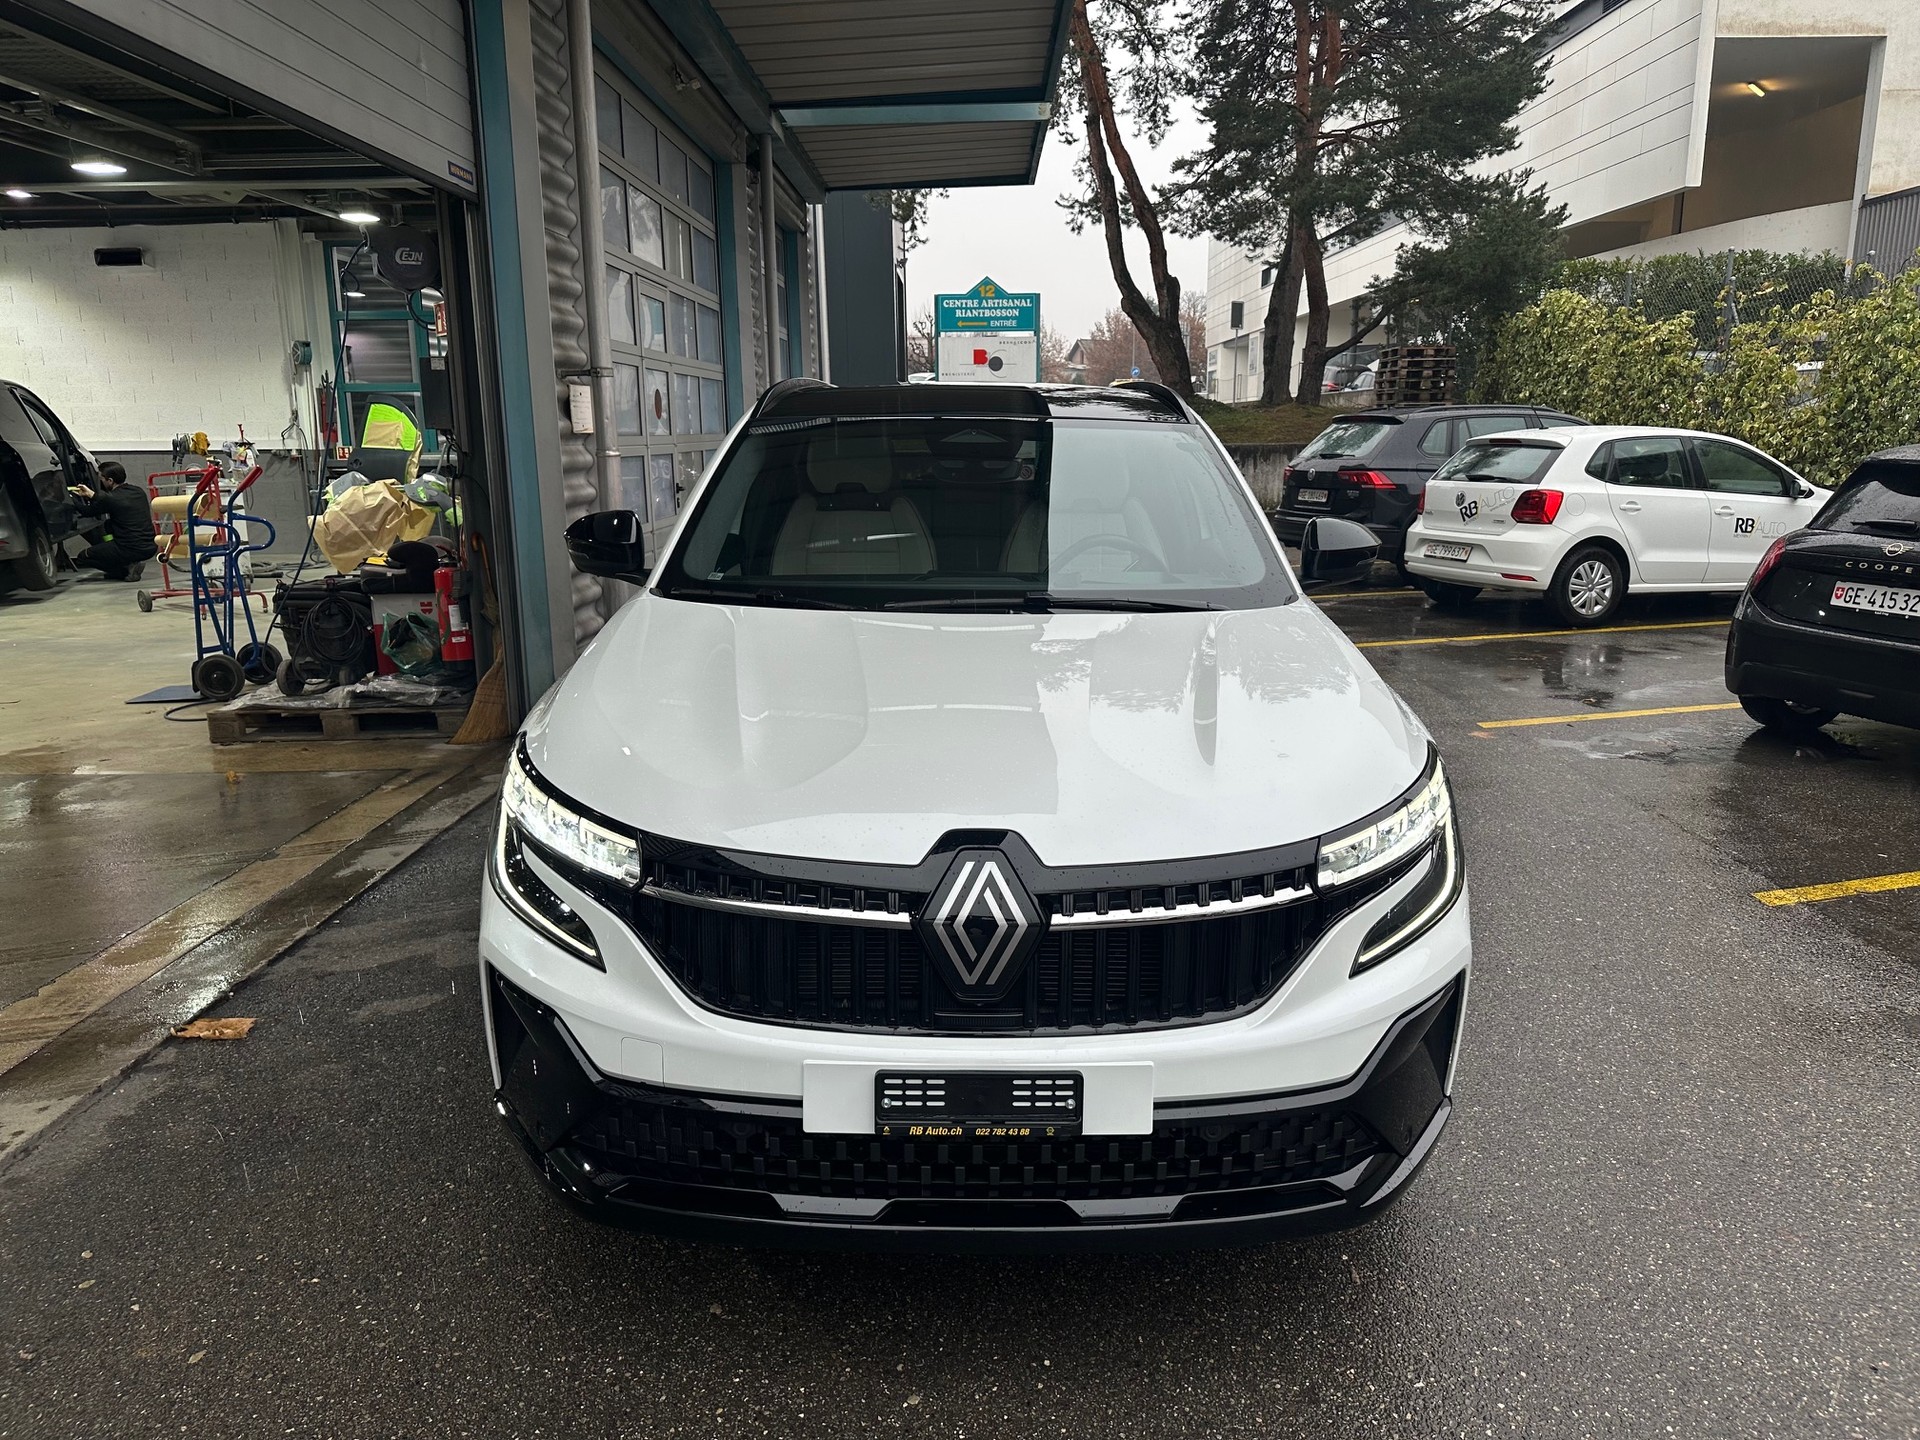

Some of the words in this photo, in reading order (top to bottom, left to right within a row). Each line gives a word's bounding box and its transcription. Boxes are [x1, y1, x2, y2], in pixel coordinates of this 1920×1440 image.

[395, 247, 424, 265] CEJN
[978, 285, 995, 297] 12
[943, 299, 979, 308] CENTRE
[981, 299, 1032, 307] ARTISANAL
[955, 309, 1019, 318] RIANTBOSSON
[990, 319, 1017, 327] ENTRÉE
[1460, 501, 1478, 523] RB
[1480, 486, 1515, 509] AUTO
[1734, 517, 1755, 533] RB
[1756, 521, 1787, 535] AUTO
[1845, 561, 1914, 574] COOPE
[909, 1126, 923, 1135] RB
[925, 1126, 963, 1136] Auto.ch
[975, 1128, 990, 1136] 022
[992, 1128, 1006, 1136] 782
[1008, 1128, 1018, 1136] 43
[1019, 1128, 1031, 1136] 88
